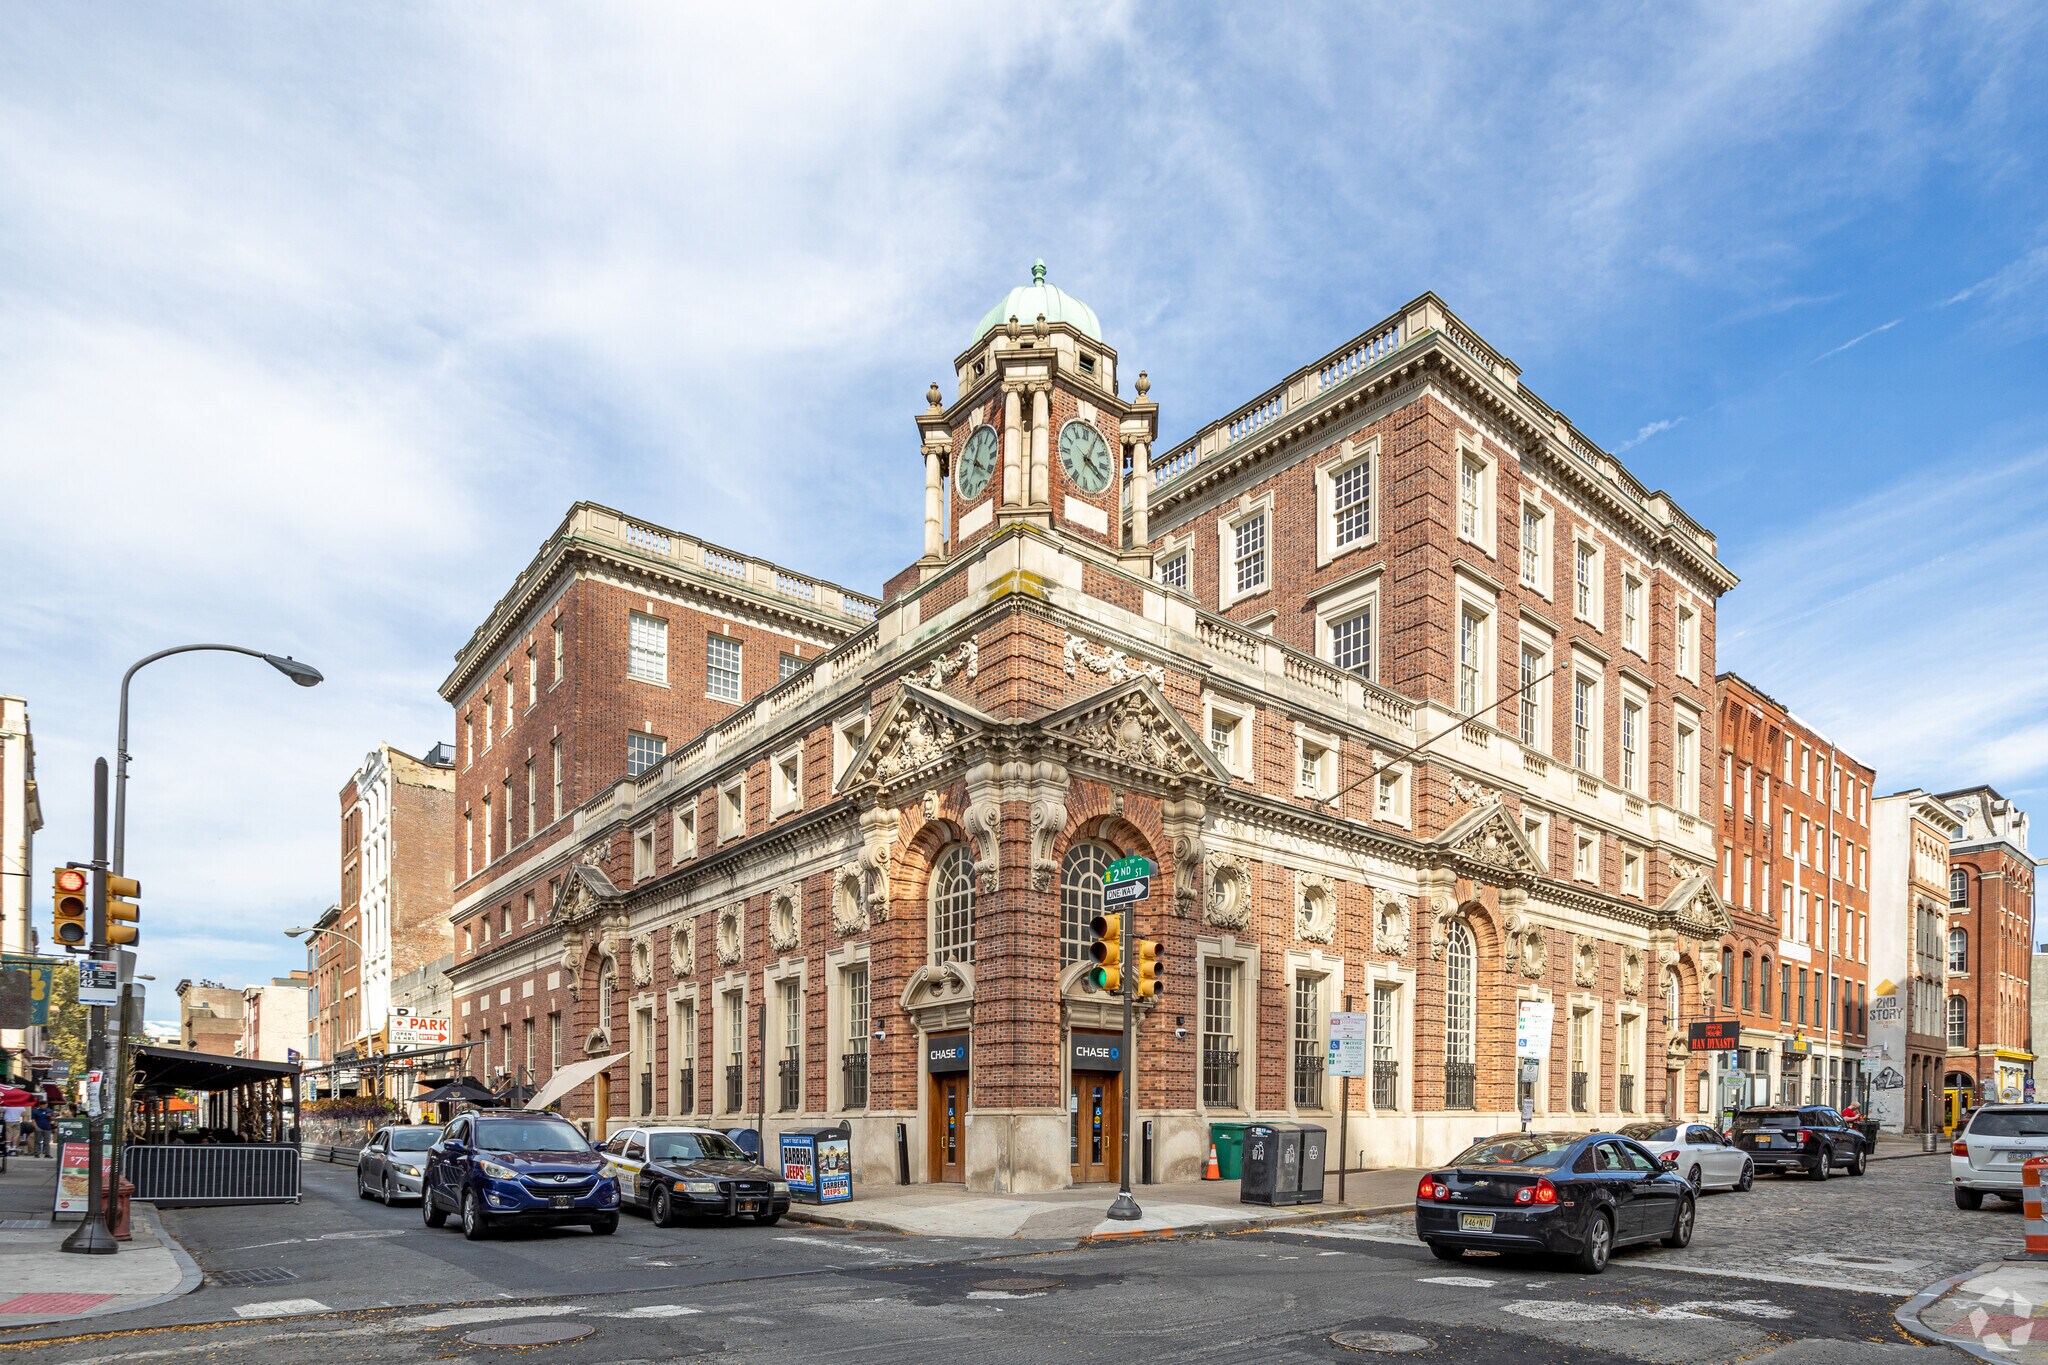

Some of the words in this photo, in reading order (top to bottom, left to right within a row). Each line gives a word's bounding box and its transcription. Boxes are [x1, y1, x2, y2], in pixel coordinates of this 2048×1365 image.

[1213, 819, 1245, 837] CORN
[1113, 866, 1131, 882] 2ND
[1135, 868, 1142, 877] ST
[1108, 890, 1120, 899] ONE
[1122, 886, 1135, 896] WAY
[81, 980, 94, 988] 42
[1876, 997, 1896, 1008] 2ND
[1869, 1008, 1904, 1021] STORY
[410, 1018, 447, 1031] PARK
[1692, 1038, 1706, 1050] HAN
[1707, 1037, 1736, 1049] DYNASTY
[930, 1048, 956, 1060] CHASE
[1076, 1046, 1110, 1058] CHASE
[1884, 1069, 1895, 1088] 2
[784, 1147, 812, 1165] BARBERA
[785, 1165, 805, 1181] JEEPS
[822, 1180, 848, 1190] BARBERA
[823, 1188, 842, 1196] JEEPS
